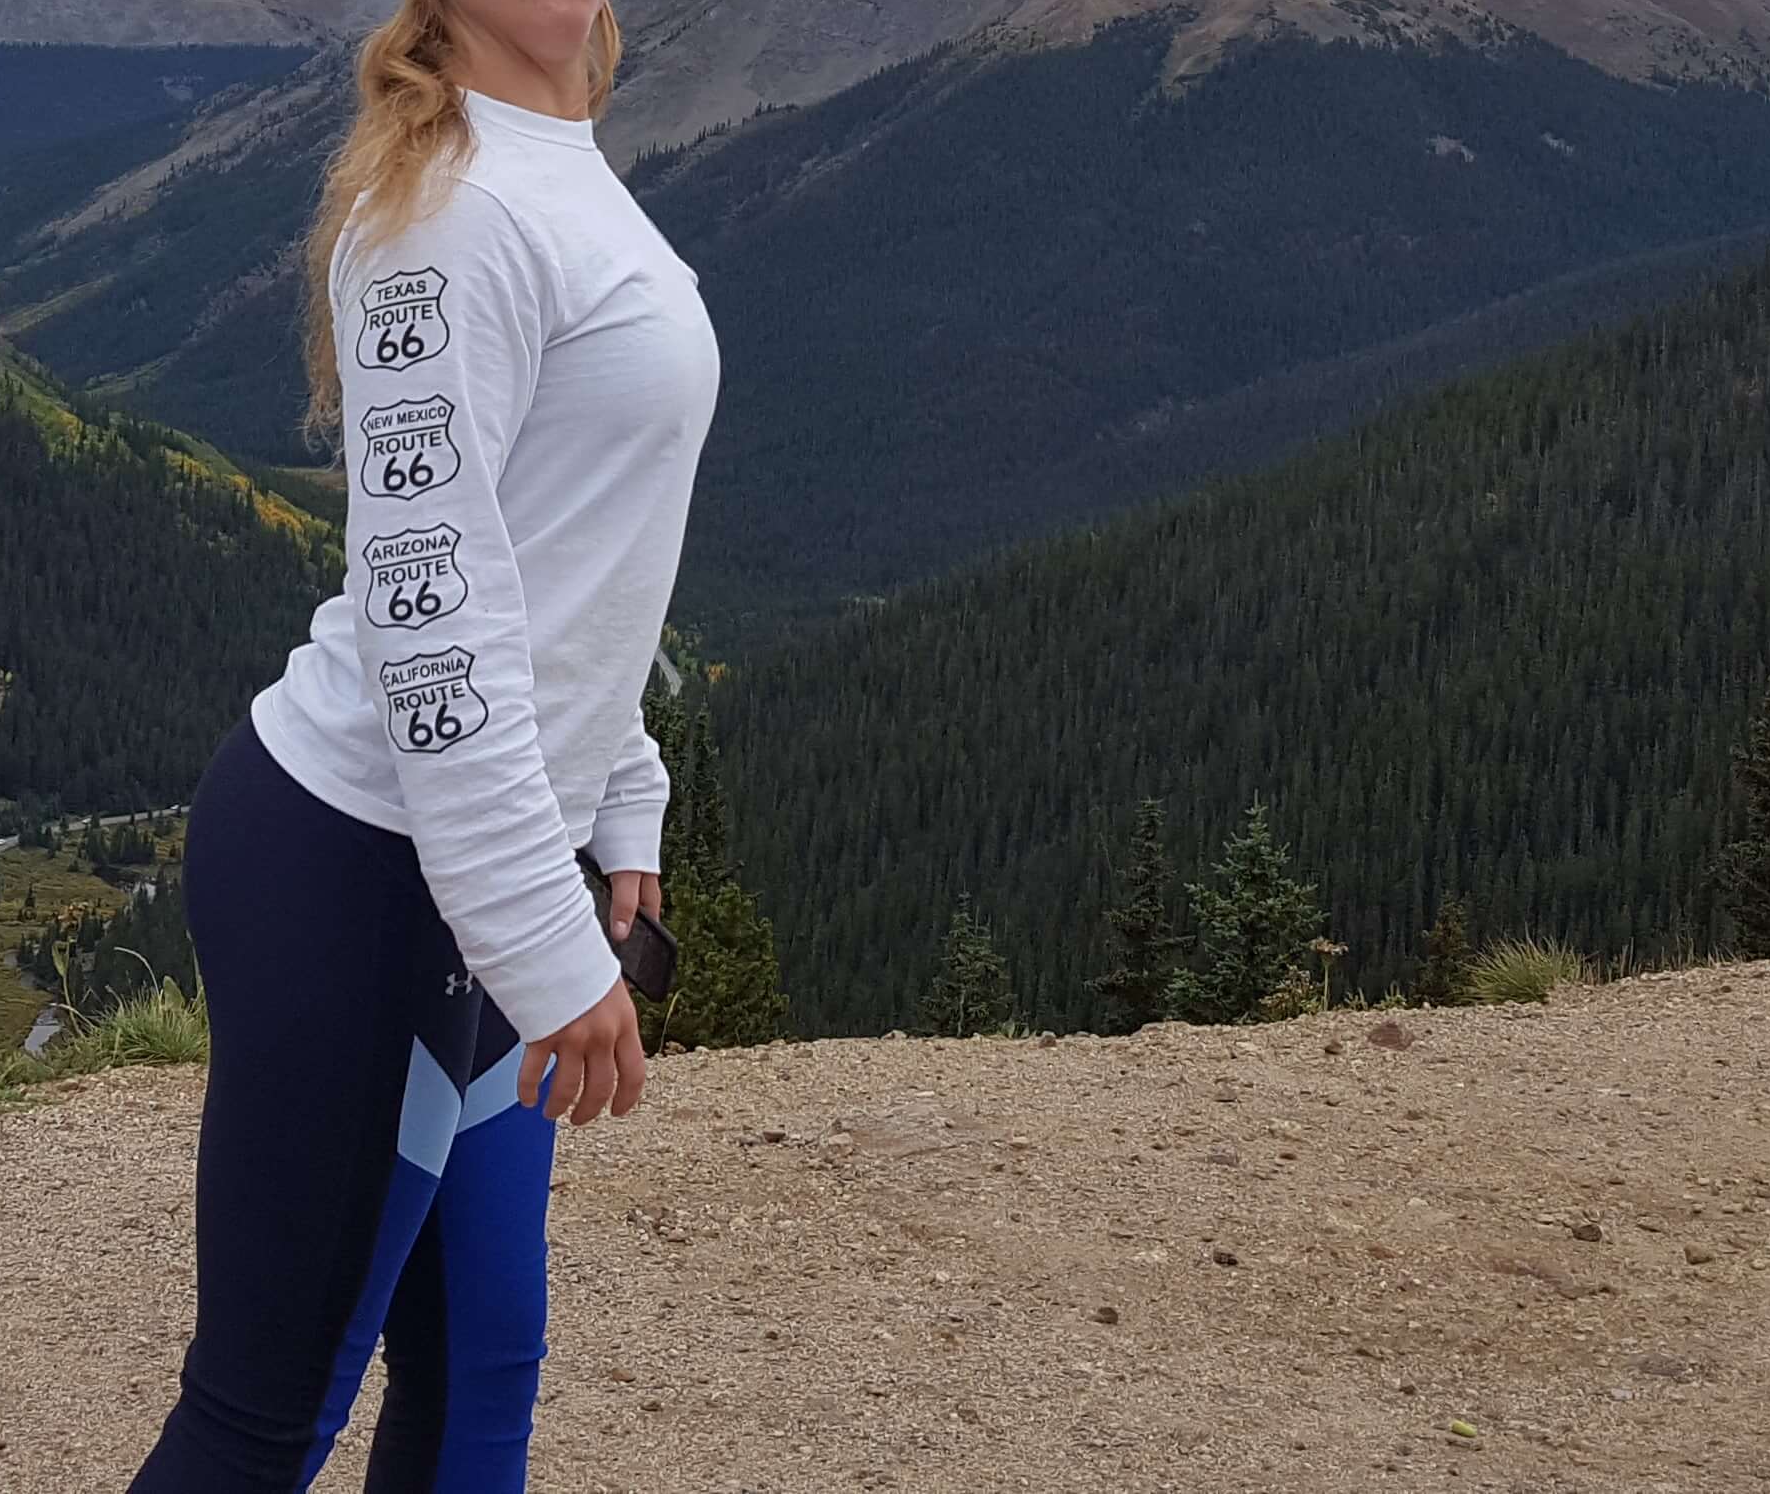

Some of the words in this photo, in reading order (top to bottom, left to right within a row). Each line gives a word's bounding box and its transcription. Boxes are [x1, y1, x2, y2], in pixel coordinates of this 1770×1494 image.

[376, 279, 427, 303] TEXAS
[369, 303, 434, 331] ROUTE
[376, 322, 425, 364] 66
[367, 414, 393, 431] NEW
[396, 405, 448, 426] MEXICO
[373, 430, 443, 458] ROUTE
[383, 451, 434, 492] 66
[371, 533, 451, 562] ARIZONA
[377, 558, 449, 588] ROUTE
[389, 579, 442, 622] 66
[383, 657, 466, 687] CALIFORNIA
[393, 681, 466, 714] ROUTE
[408, 702, 463, 748] 66
